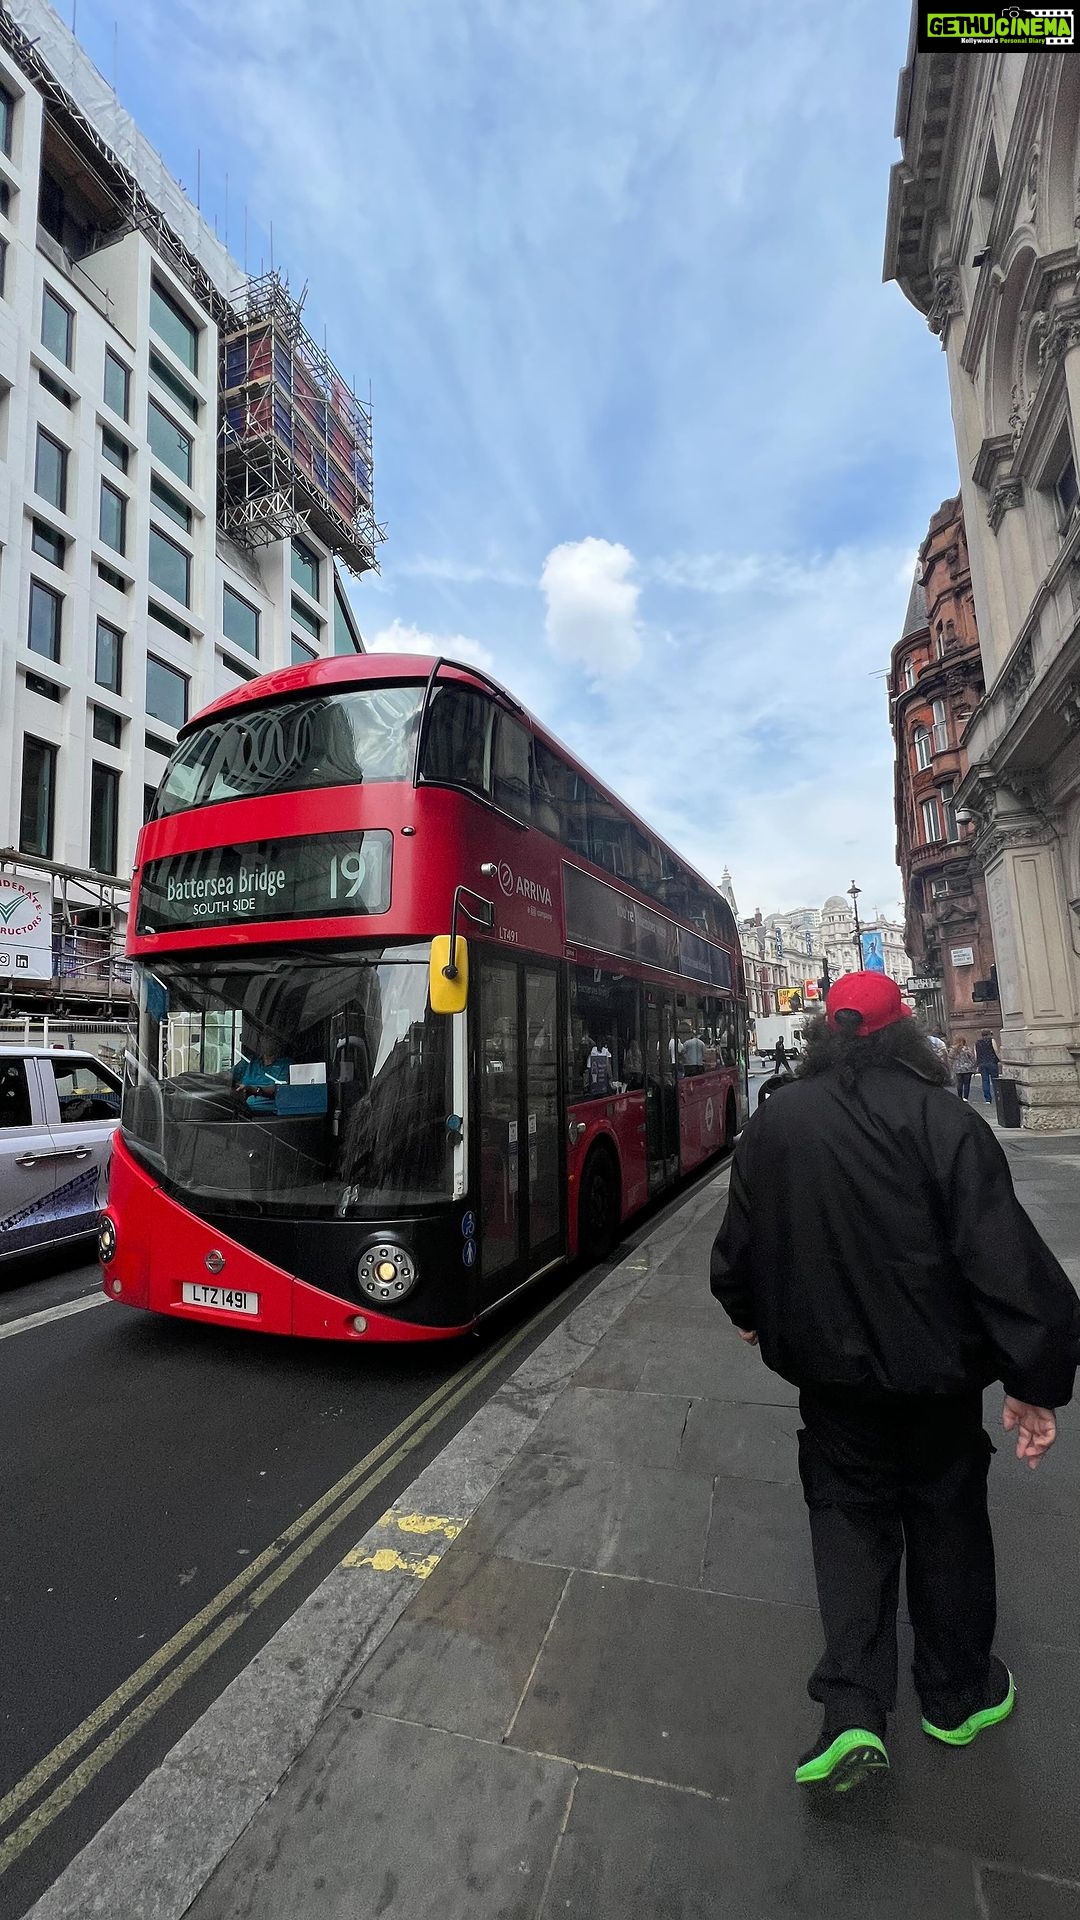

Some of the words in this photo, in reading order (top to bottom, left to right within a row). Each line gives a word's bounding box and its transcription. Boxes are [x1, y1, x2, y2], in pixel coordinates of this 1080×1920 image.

[167, 875, 234, 901] Battersea
[239, 864, 286, 897] Bridge
[329, 852, 366, 899] 19
[516, 876, 552, 907] ARRIVA
[193, 901, 230, 915] SOUTH
[232, 898, 256, 911] SIDE
[499, 927, 519, 942] LT491
[193, 1285, 218, 1304] LTZ
[222, 1290, 246, 1309] 1491
